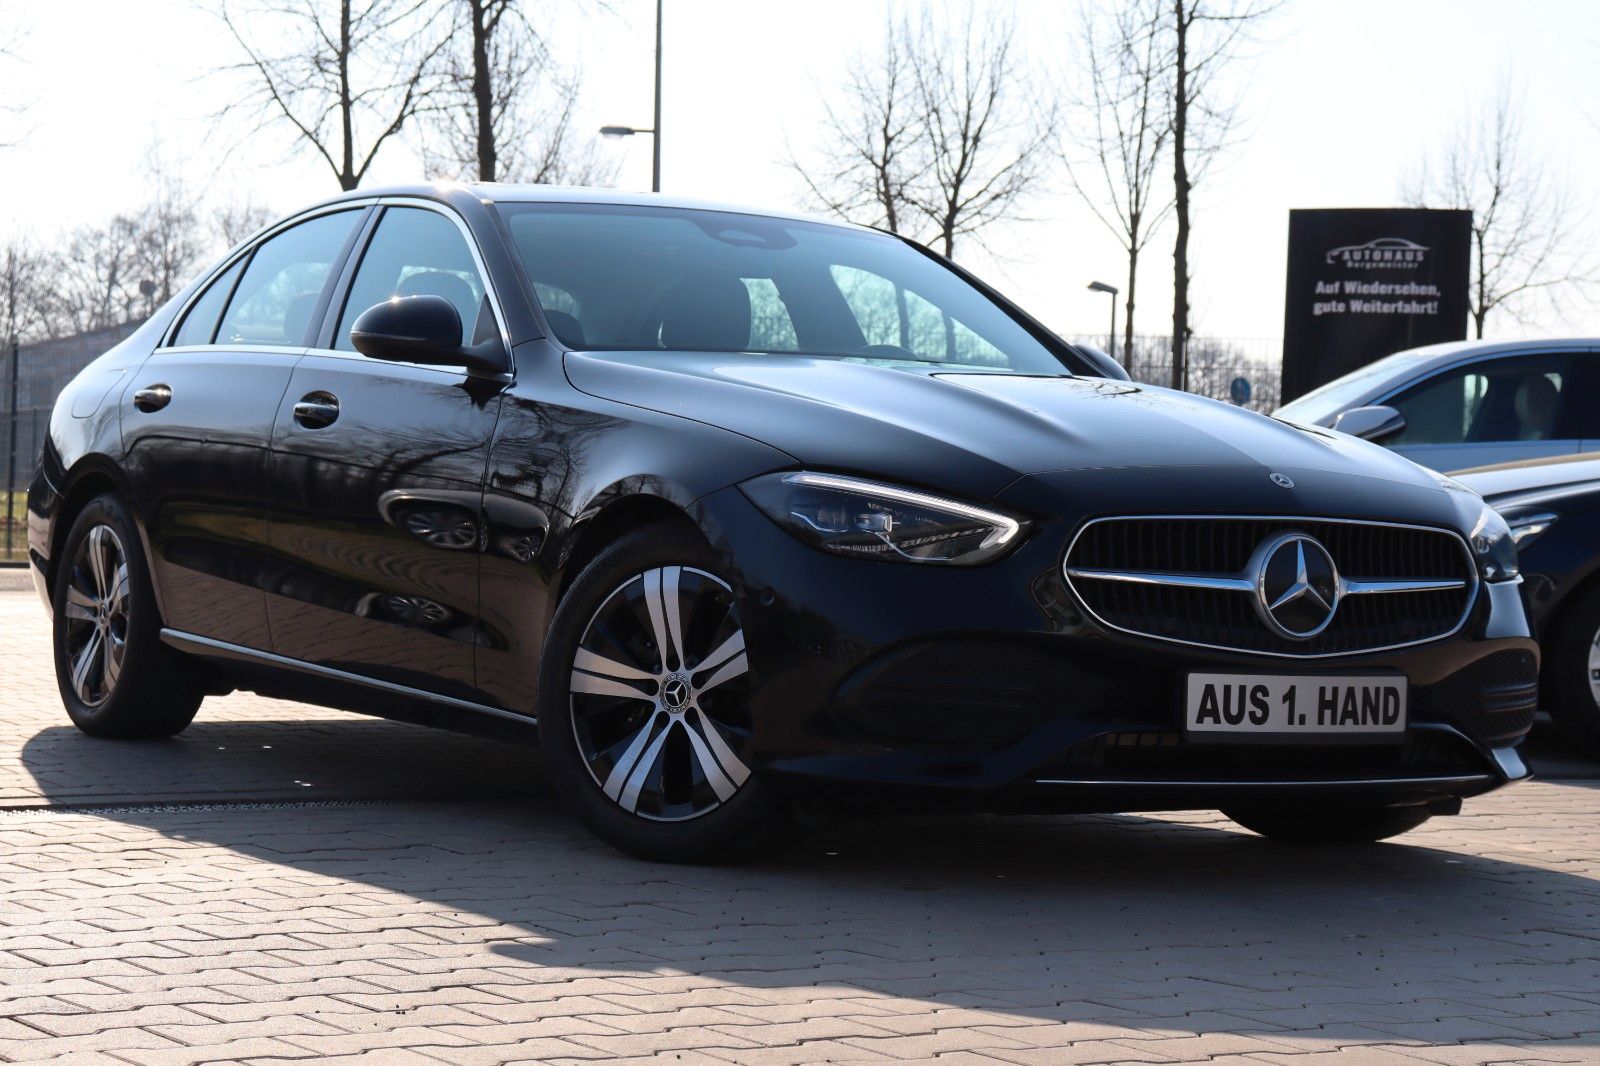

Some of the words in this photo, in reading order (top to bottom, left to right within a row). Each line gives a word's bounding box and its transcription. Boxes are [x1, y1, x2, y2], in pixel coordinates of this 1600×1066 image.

[1342, 250, 1424, 261] AUTOHAUS
[1315, 281, 1340, 294] Auf
[1343, 281, 1440, 296] Wiedersehen,
[1313, 300, 1345, 315] gute
[1350, 300, 1438, 314] Weiterfahrt!
[1195, 683, 1270, 726] AUS
[1282, 684, 1306, 726] 1.
[1317, 686, 1400, 726] HAND
